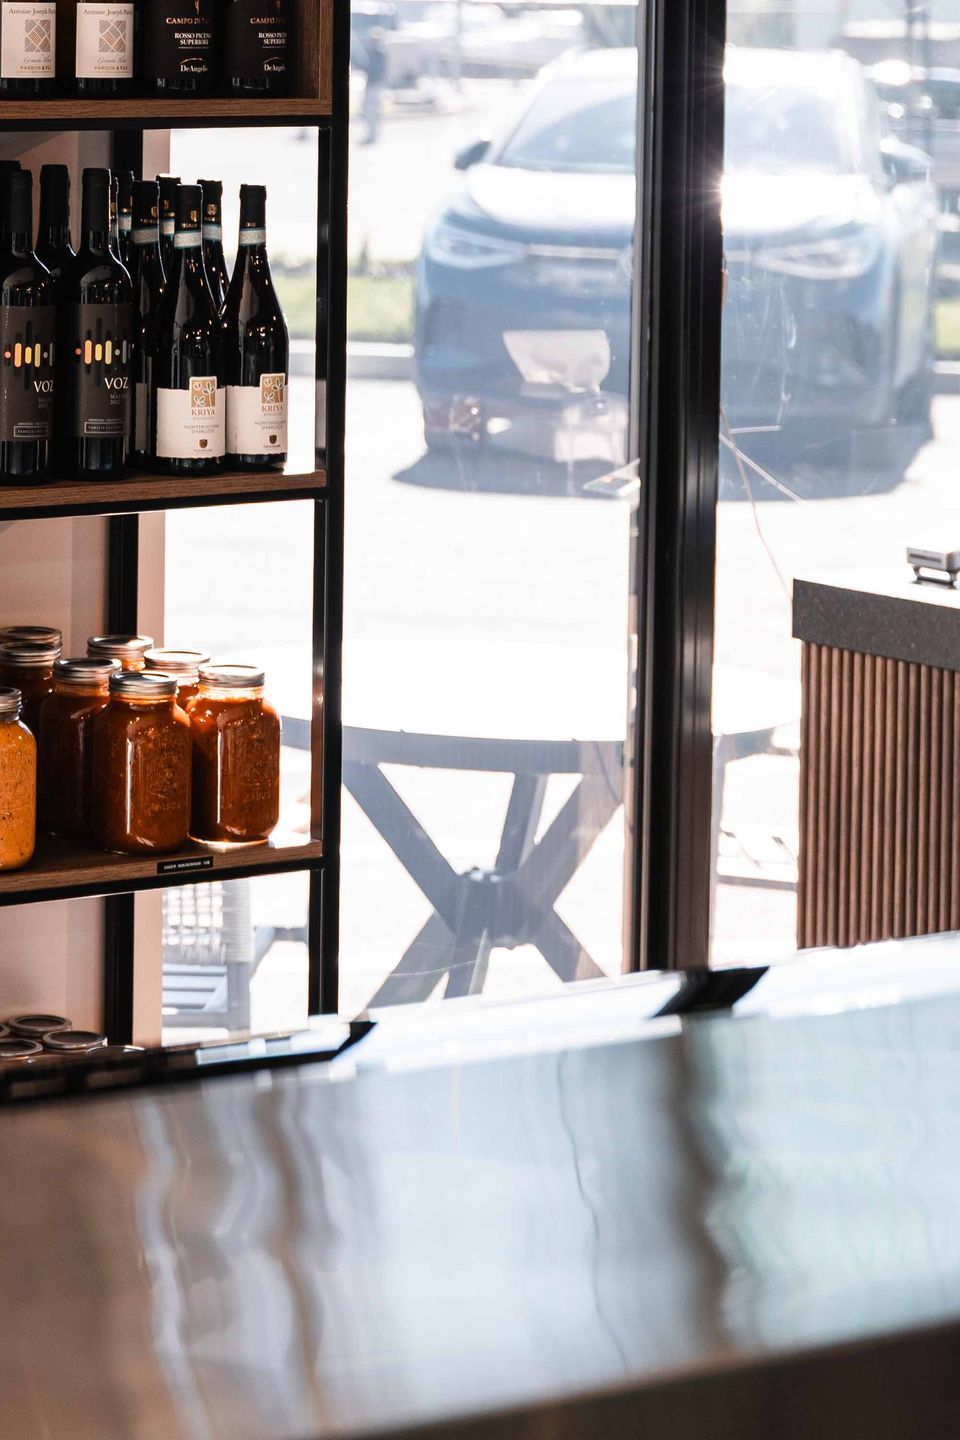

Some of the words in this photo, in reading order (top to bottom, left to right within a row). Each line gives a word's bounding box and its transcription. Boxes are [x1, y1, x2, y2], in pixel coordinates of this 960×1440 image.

[34, 380, 53, 392] VOZ
[104, 377, 128, 389] VOZ
[191, 408, 216, 416] KRIYA
[261, 405, 283, 413] KRIYA
